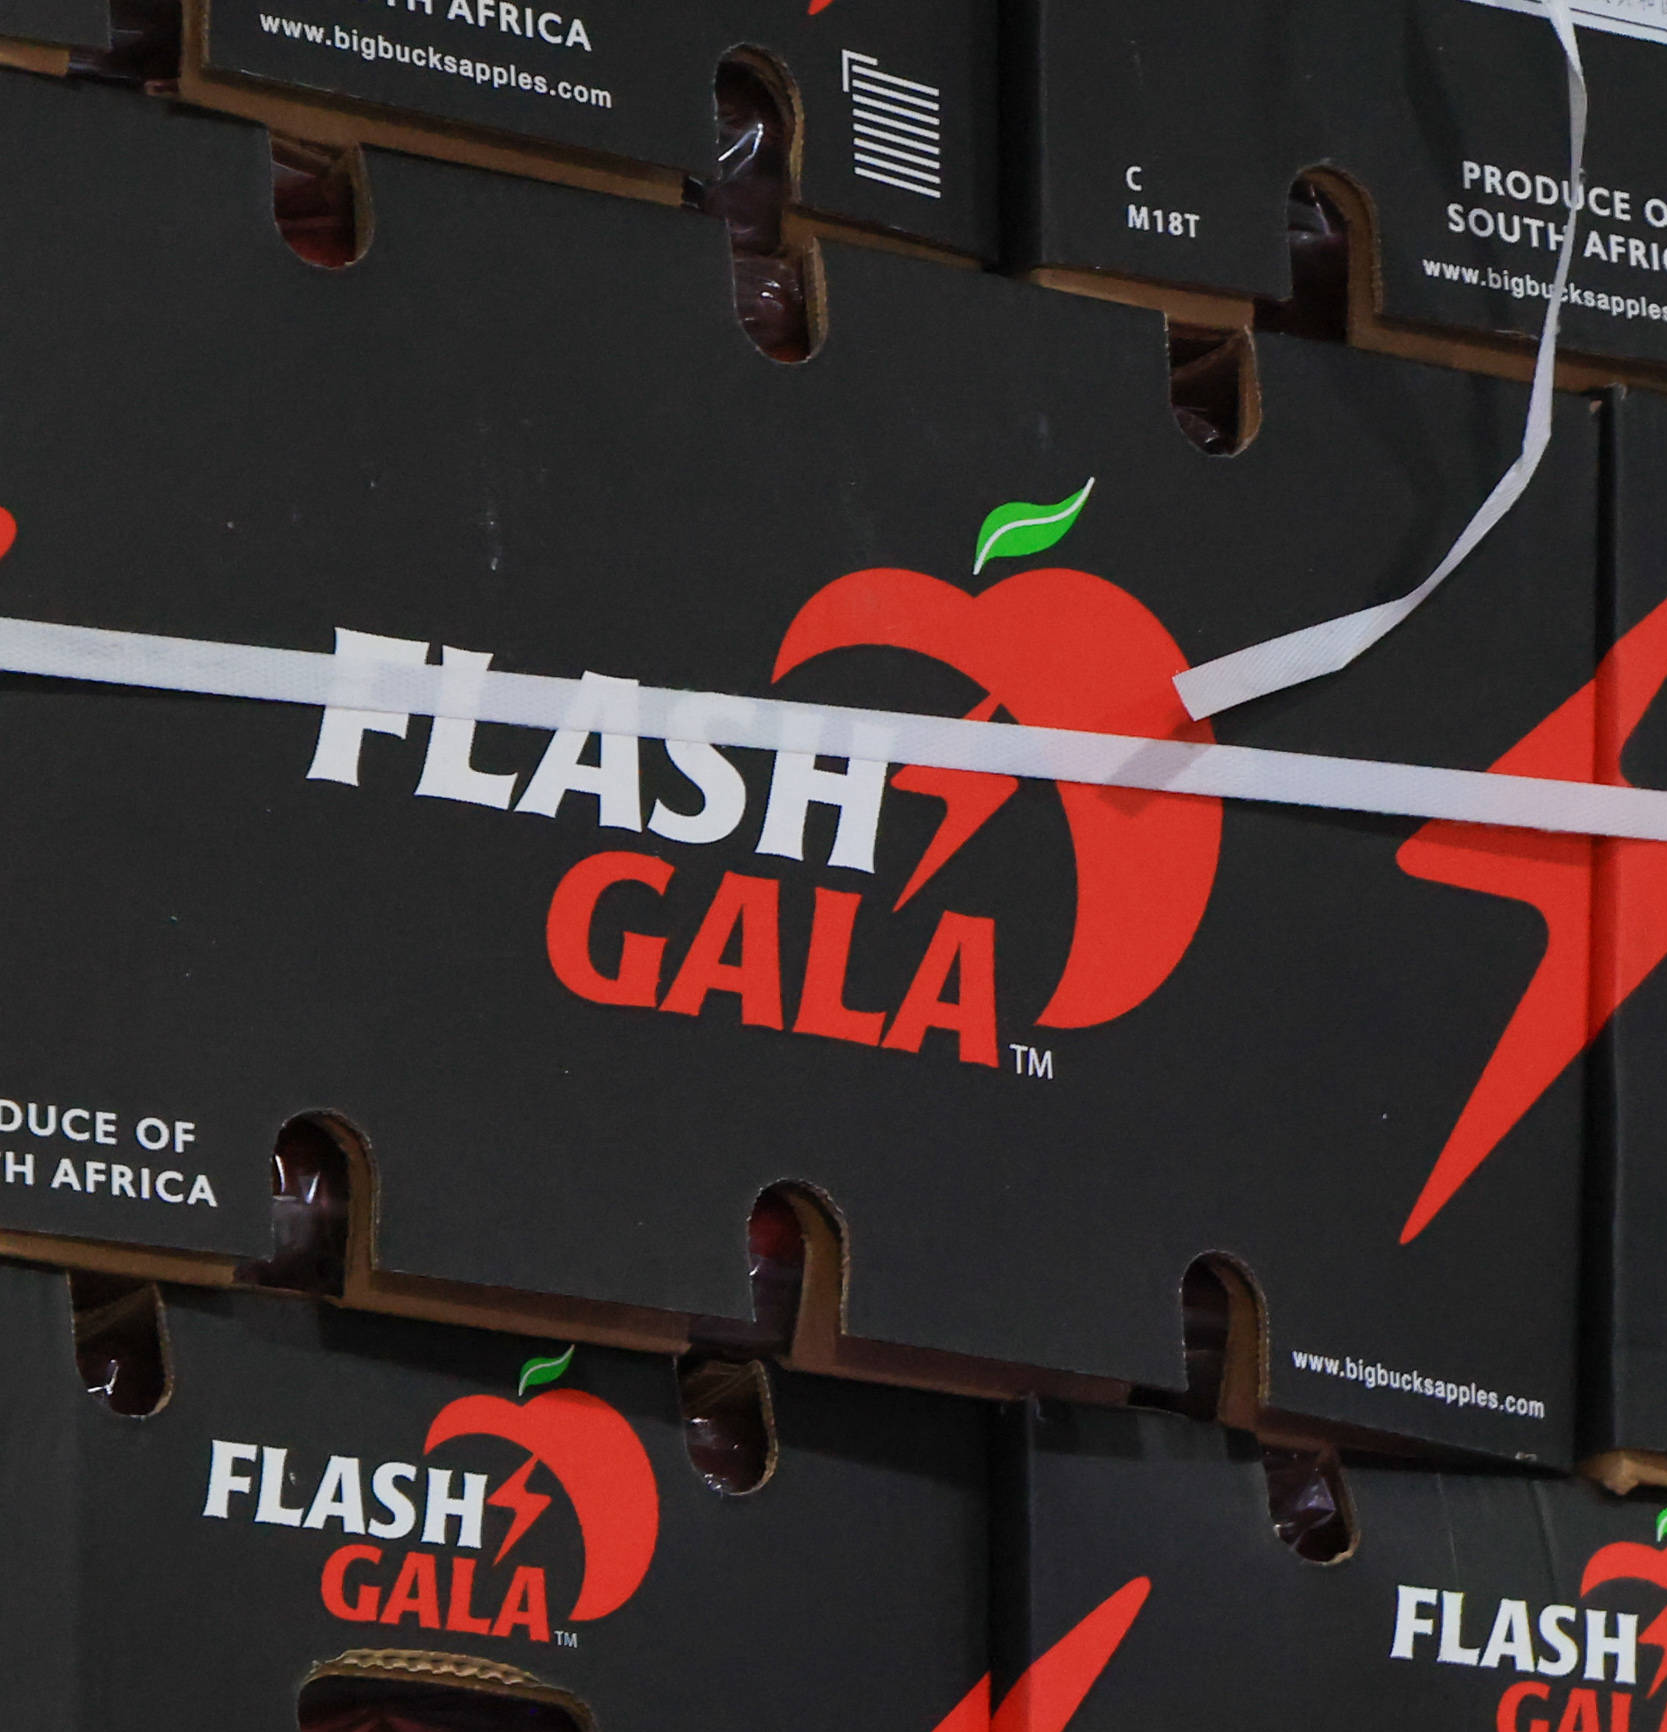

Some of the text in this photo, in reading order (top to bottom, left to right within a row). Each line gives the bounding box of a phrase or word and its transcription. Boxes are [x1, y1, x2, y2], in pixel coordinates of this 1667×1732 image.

[259, 12, 613, 109] www.bigbucksapples.com
[1125, 165, 1142, 192] C
[1462, 160, 1631, 221] PRODUCE
[1127, 204, 1200, 239] M18T
[1447, 203, 1569, 251] SOUTH
[306, 628, 896, 873] FLASH
[545, 850, 1000, 1069] GALA
[1009, 1043, 1054, 1080] TM
[0, 1098, 195, 1153] DUCE OF
[51, 1157, 218, 1208] AFRICA
[1292, 1347, 1546, 1420] www.bigbucksapples.com
[202, 1439, 489, 1552] FLASH
[321, 1543, 551, 1644] GALA
[554, 1630, 578, 1649] TM
[1390, 1584, 1640, 1685] FLASH
